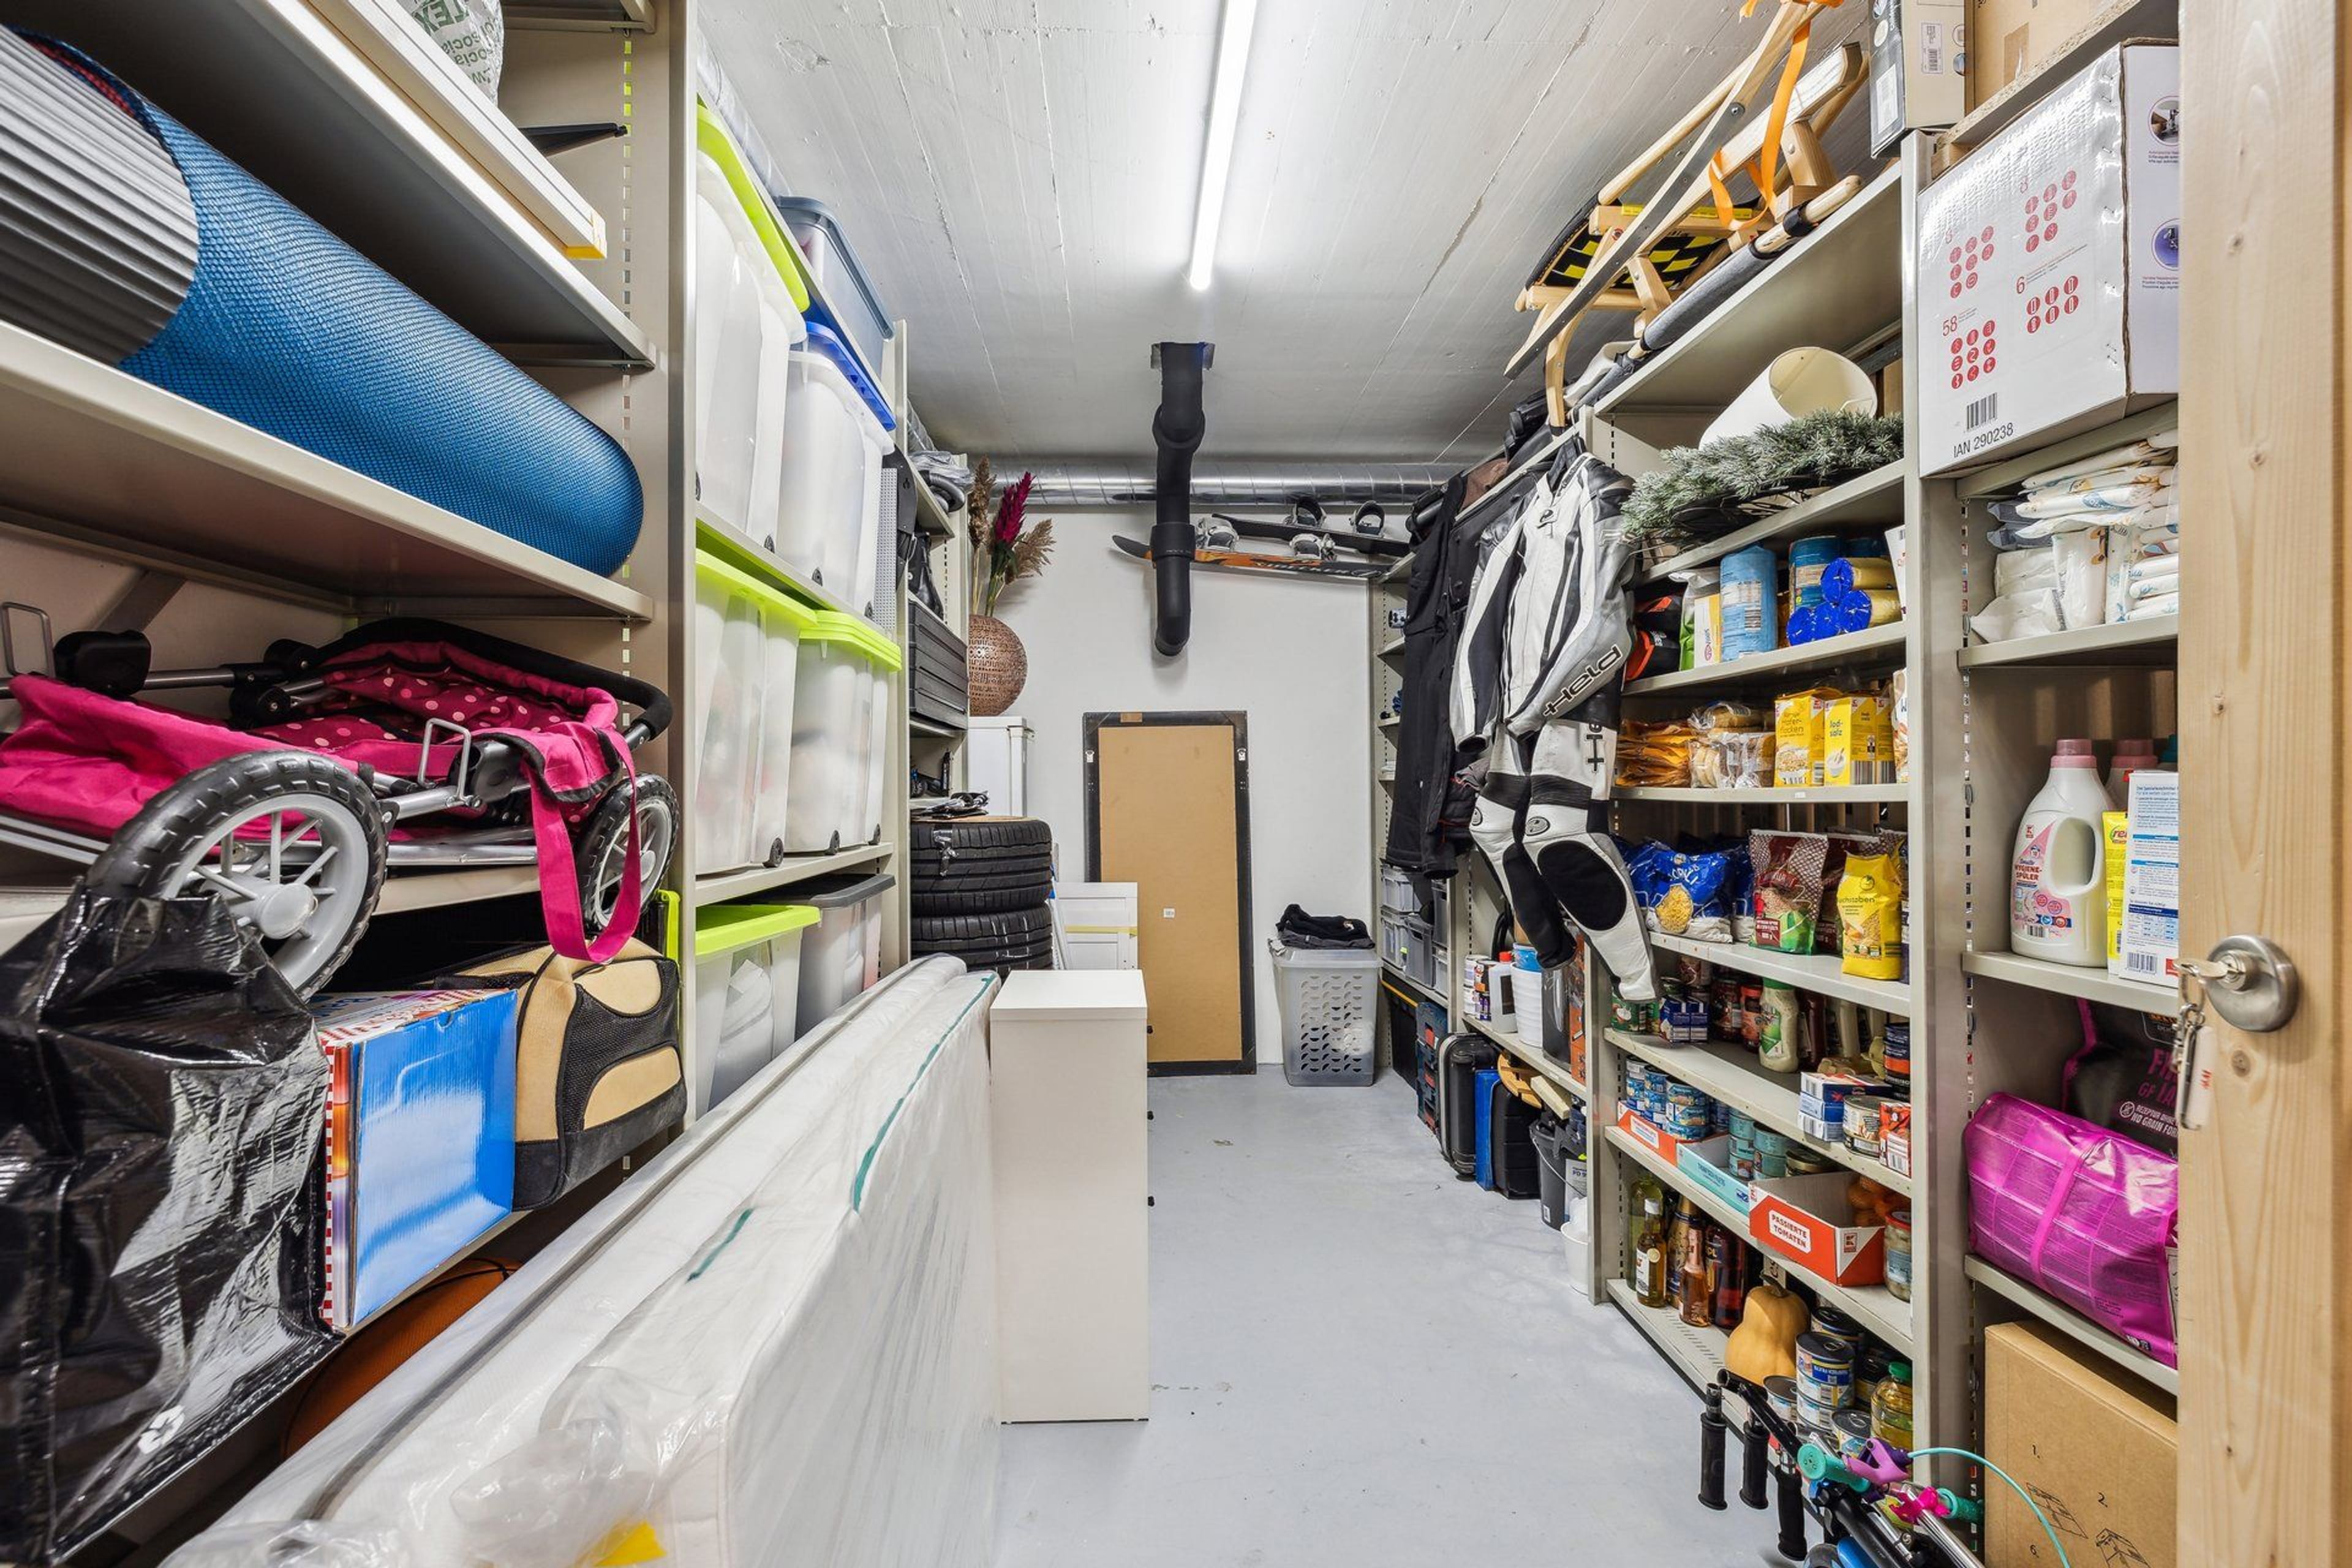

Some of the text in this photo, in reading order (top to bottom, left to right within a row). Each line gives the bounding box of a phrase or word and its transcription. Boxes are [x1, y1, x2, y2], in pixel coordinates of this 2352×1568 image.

[440, 31, 481, 55] socia
[2016, 276, 2025, 294] 6
[1942, 315, 1958, 337] 58
[1953, 423, 2014, 458] IAN 290238
[1543, 644, 1623, 717] Held
[2131, 1112, 2143, 1123] NO
[1771, 1213, 1807, 1238] PASSIERTE
[1773, 1224, 1807, 1248] TOMATEN
[2097, 1491, 2108, 1508] 2.
